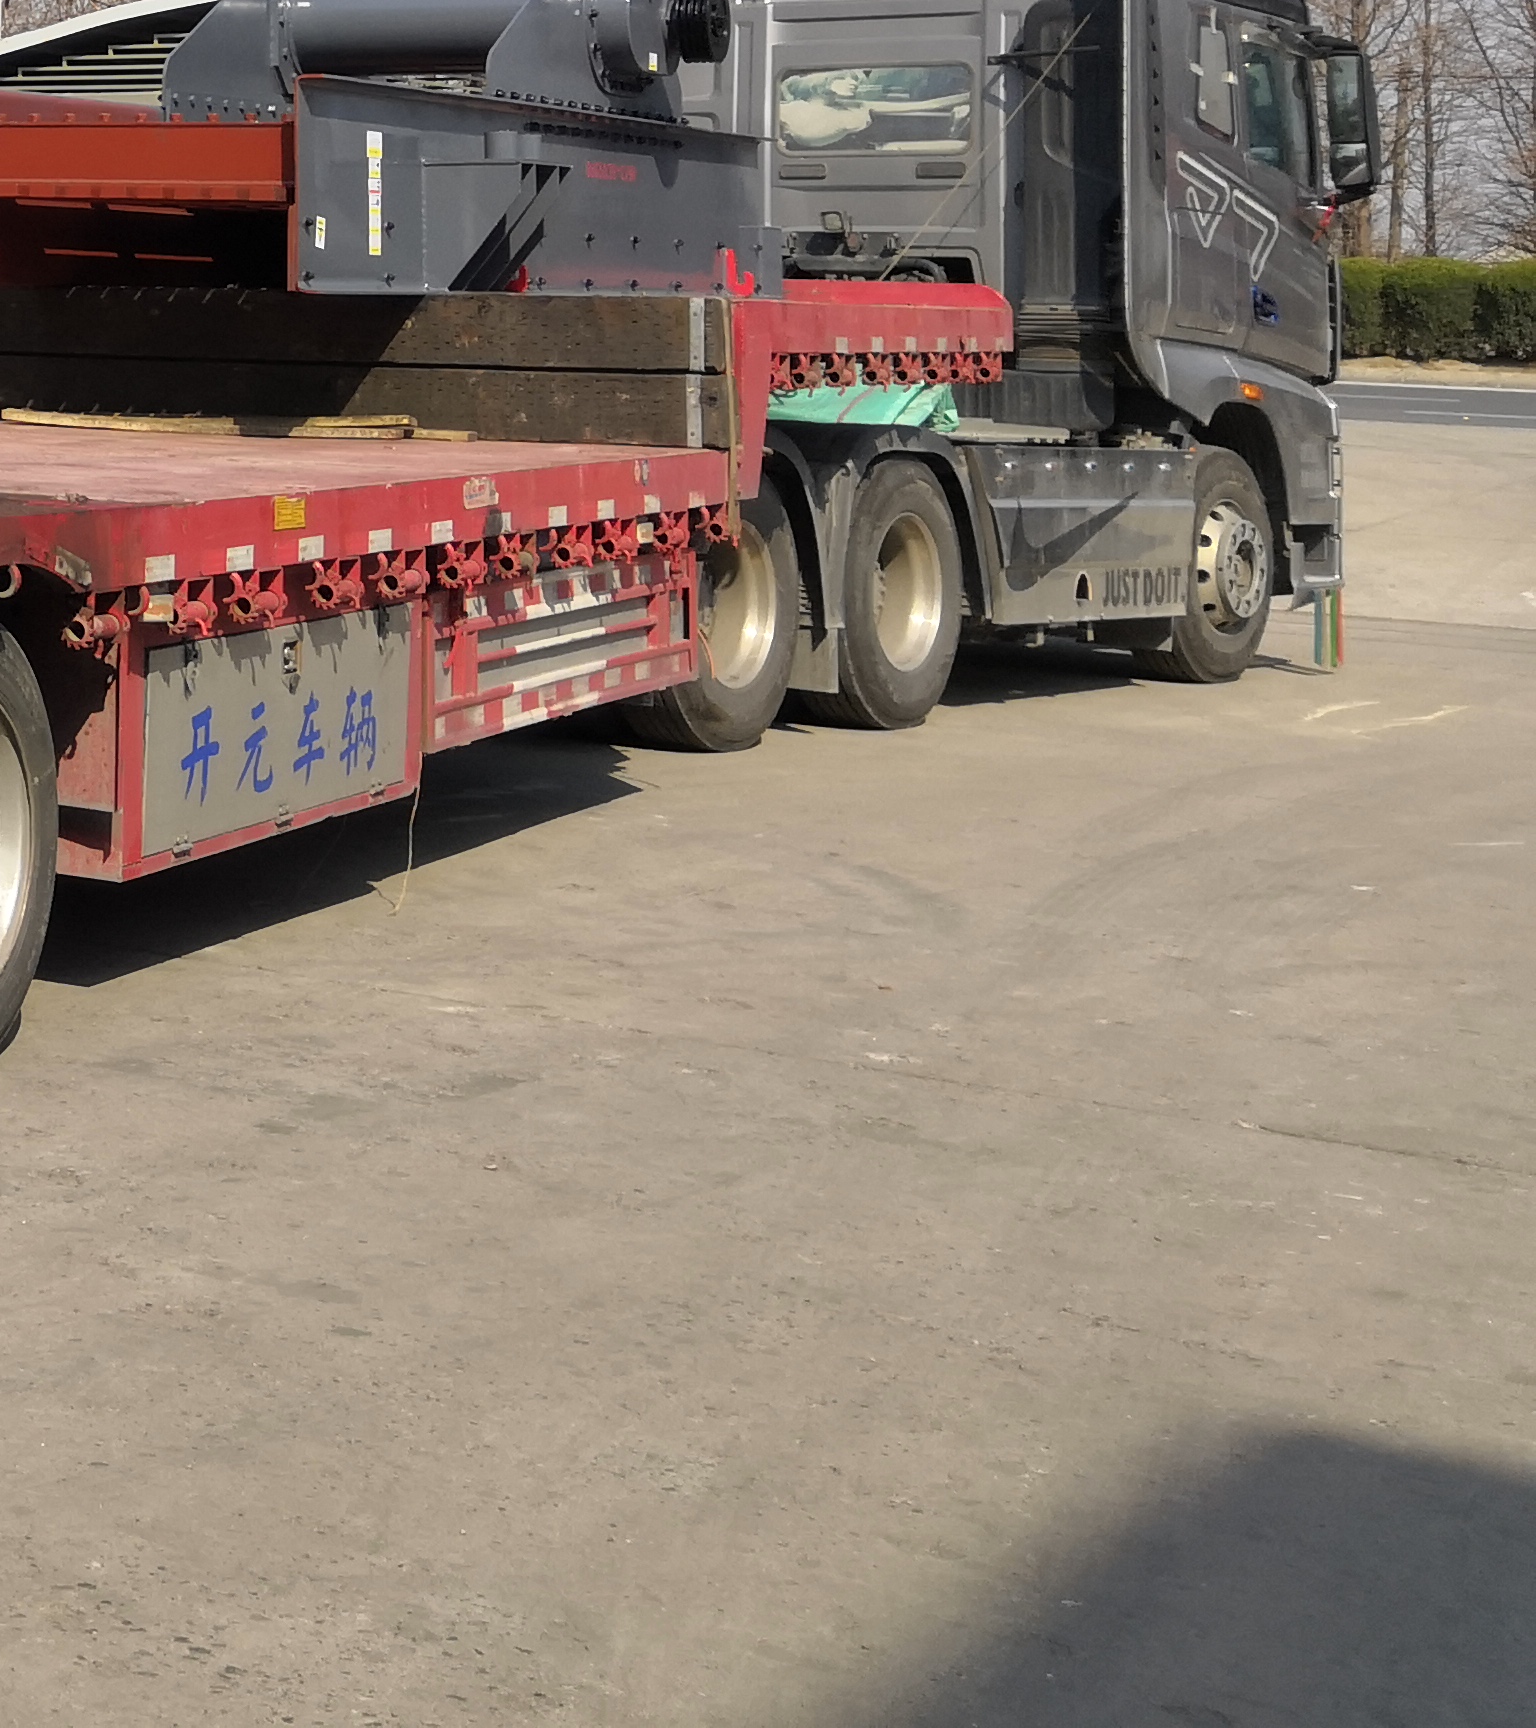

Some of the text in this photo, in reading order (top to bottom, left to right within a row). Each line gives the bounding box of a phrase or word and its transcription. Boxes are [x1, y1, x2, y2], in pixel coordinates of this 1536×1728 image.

[1102, 568, 1140, 608] JUST
[180, 685, 377, 808] 开元车辆
